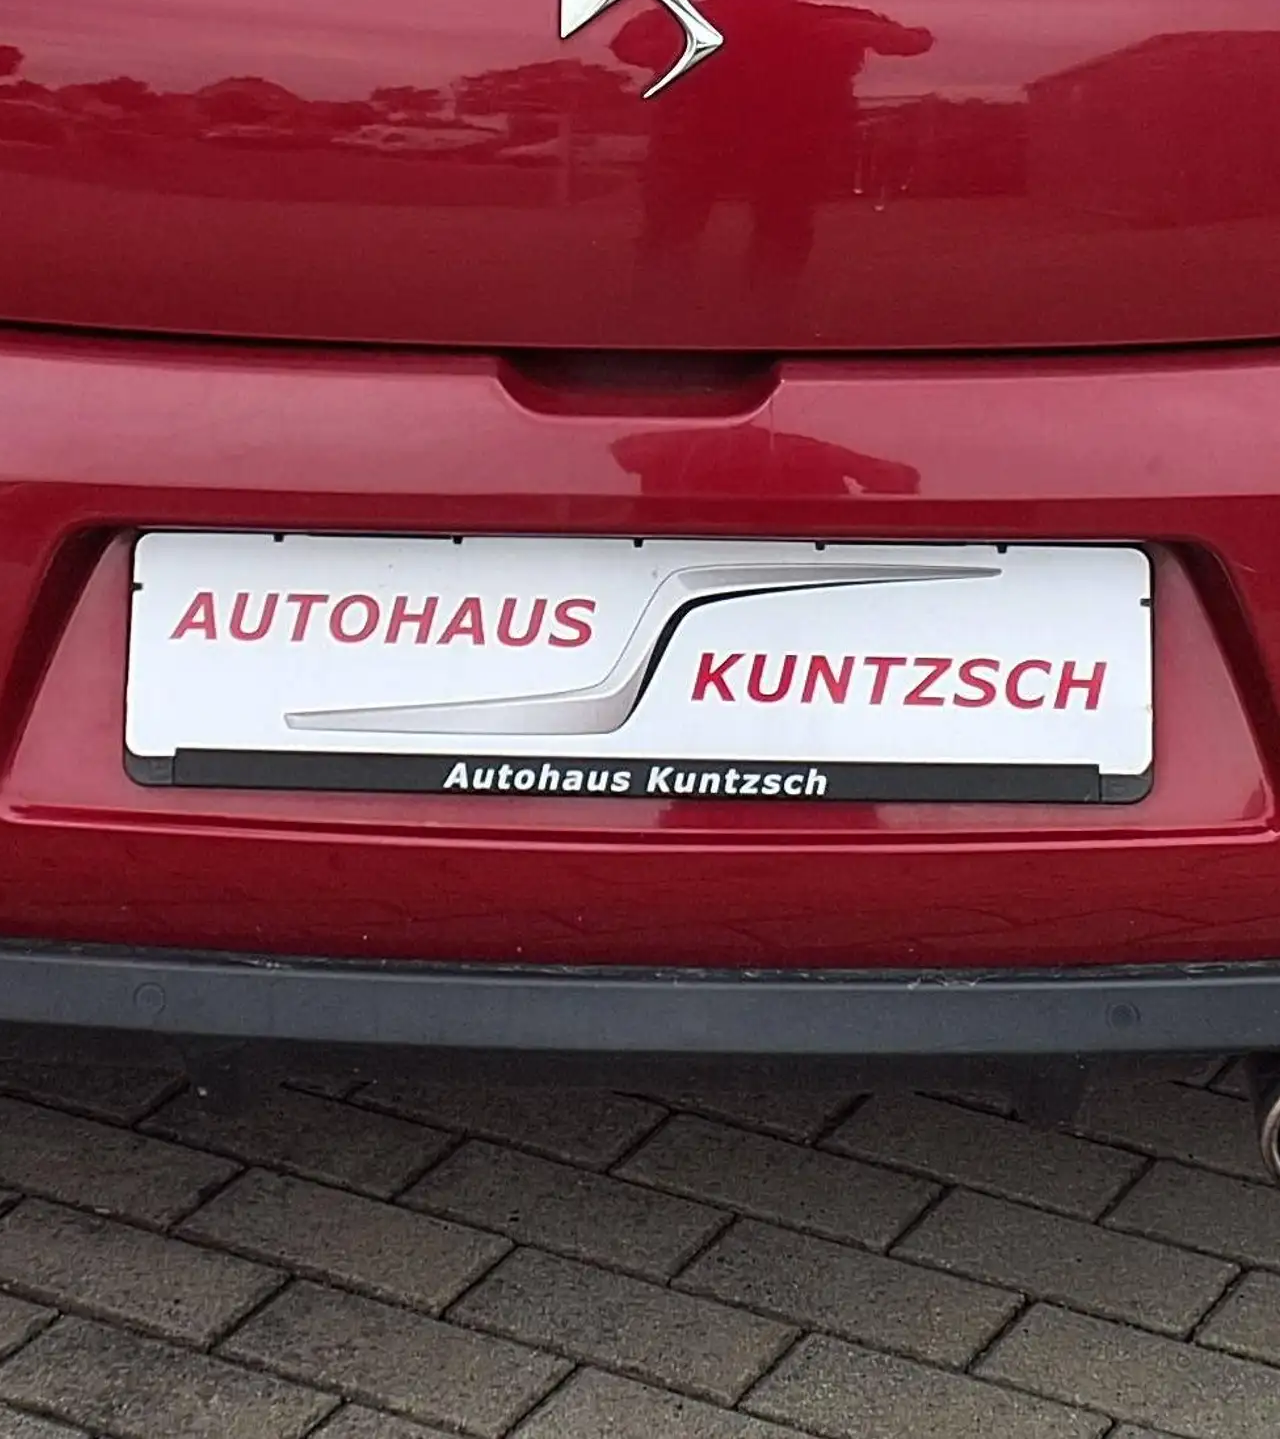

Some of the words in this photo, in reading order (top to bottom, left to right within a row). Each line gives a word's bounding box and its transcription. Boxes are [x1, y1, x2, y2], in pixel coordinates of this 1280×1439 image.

[168, 591, 597, 648] AUTOHAUS
[690, 652, 1108, 711] KUNTZSCH
[443, 761, 632, 793] Autohaus
[646, 765, 828, 796] Kuntzsch
